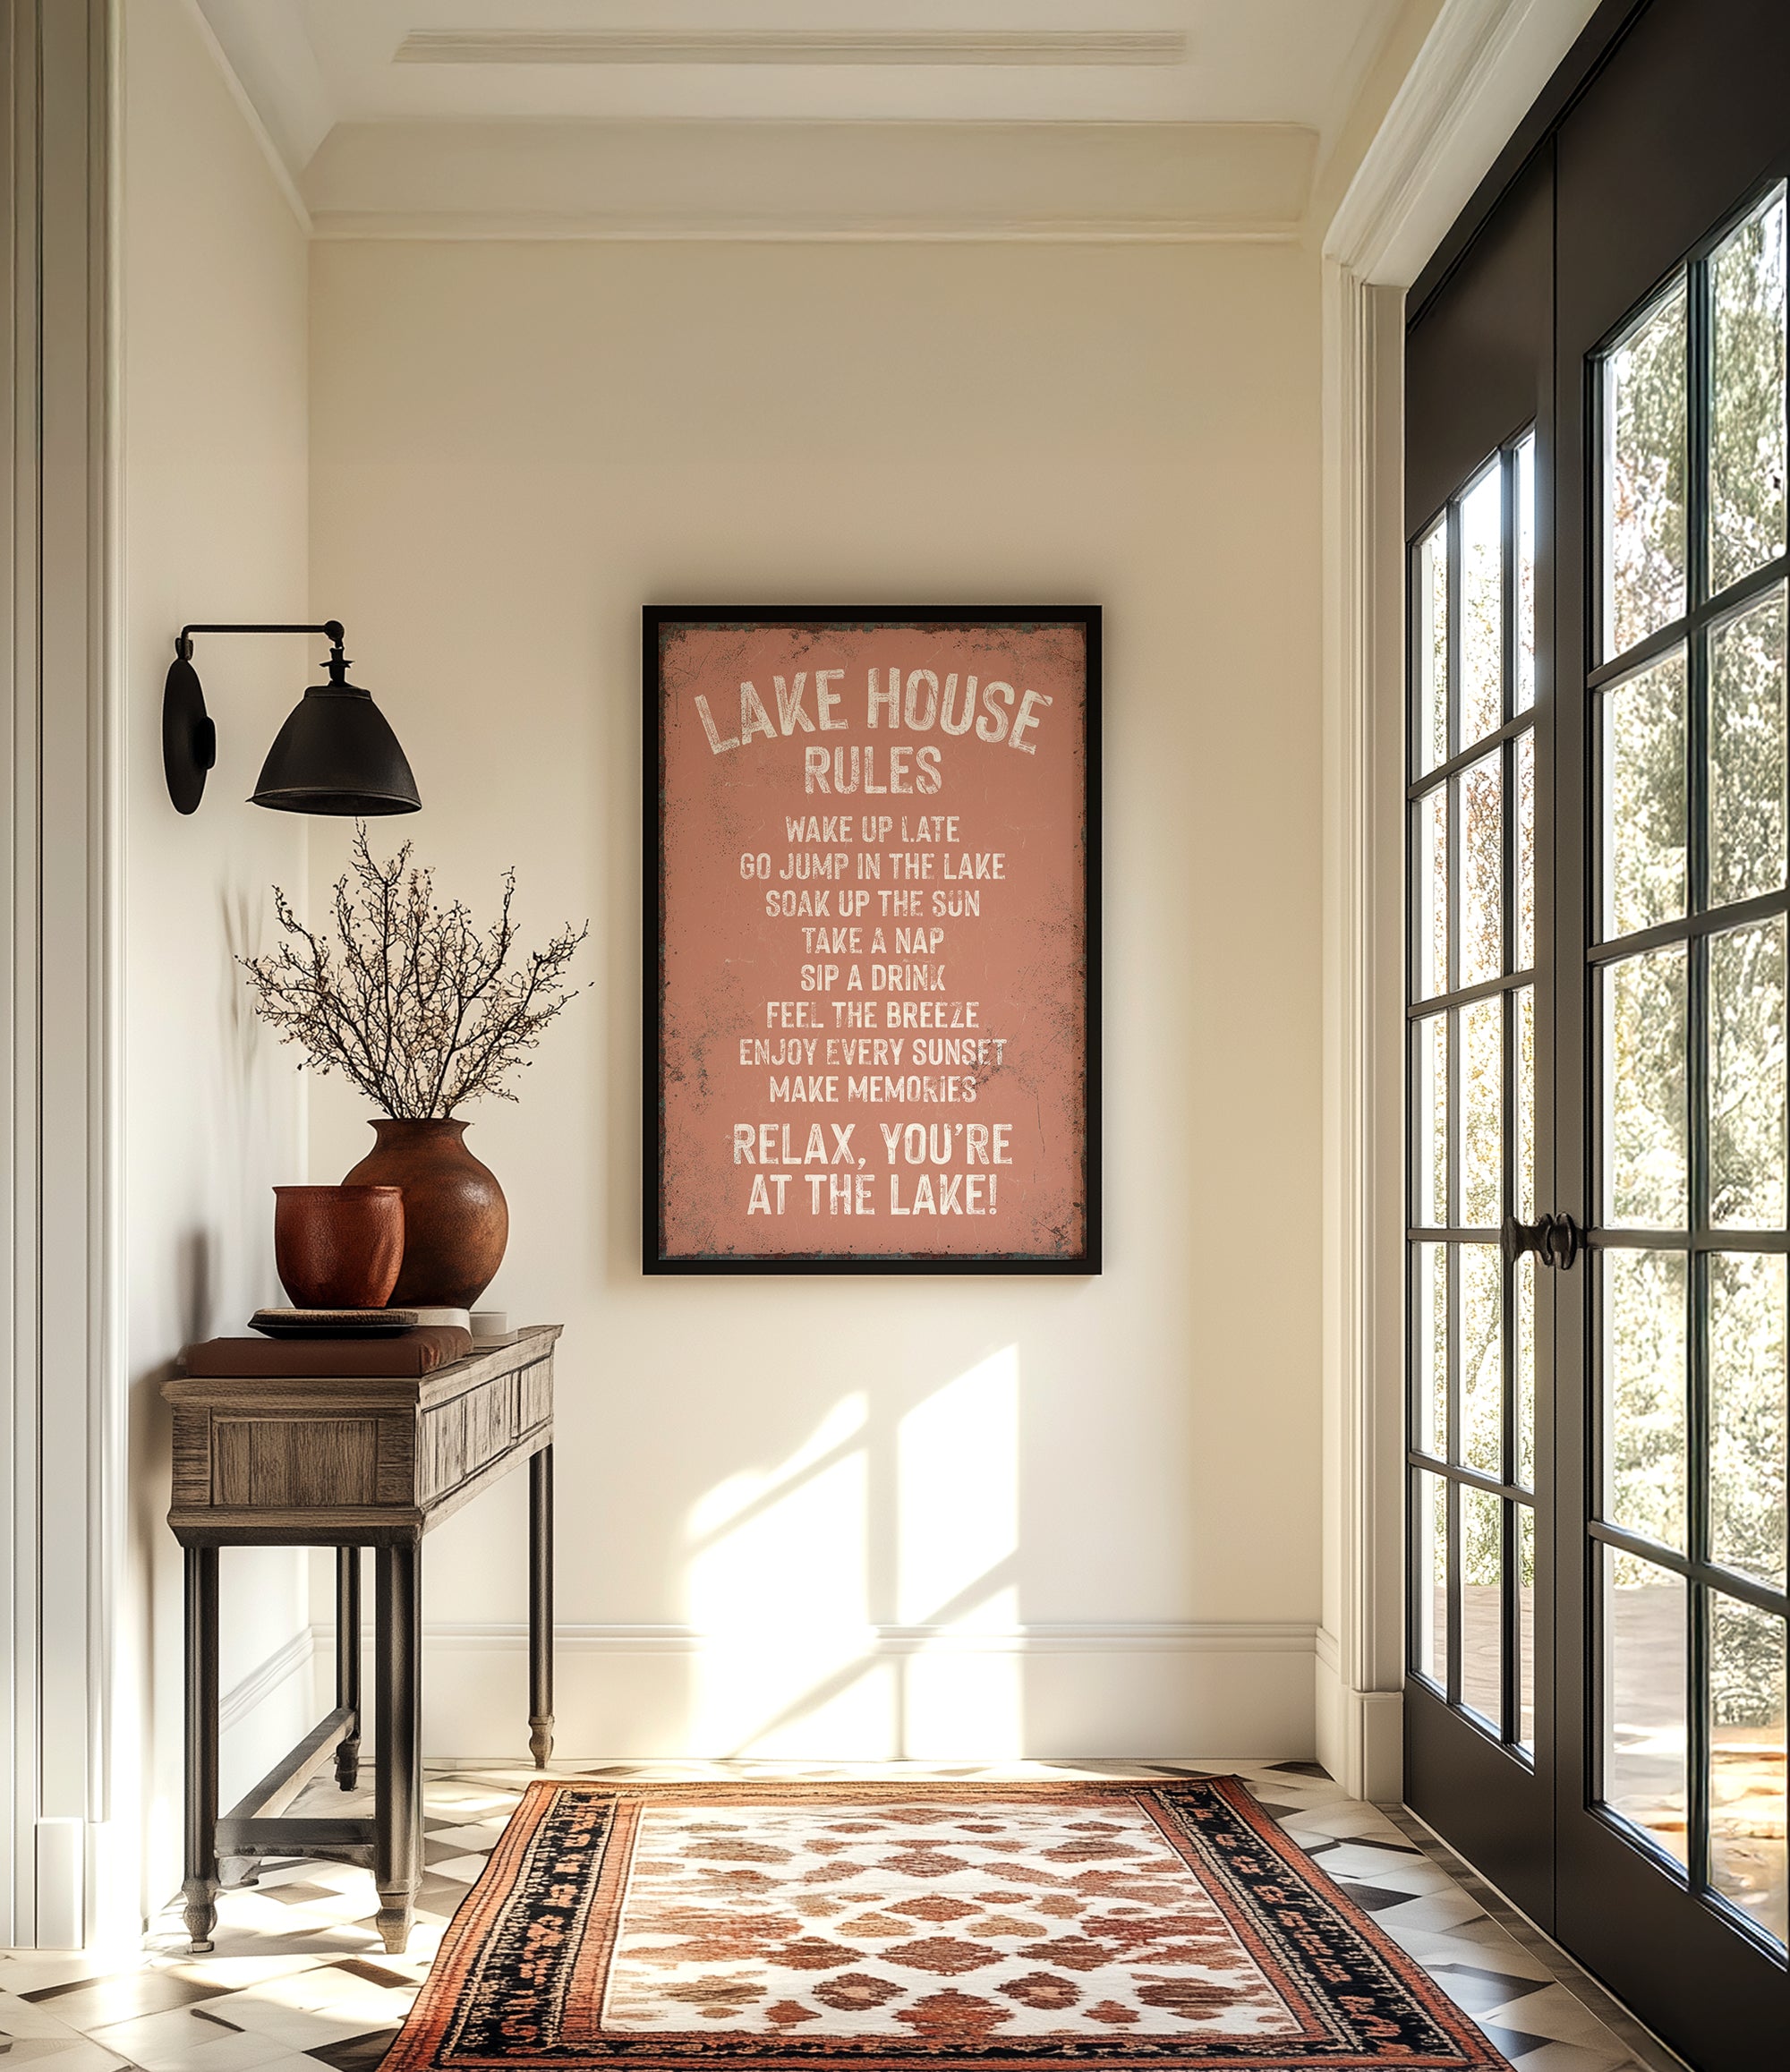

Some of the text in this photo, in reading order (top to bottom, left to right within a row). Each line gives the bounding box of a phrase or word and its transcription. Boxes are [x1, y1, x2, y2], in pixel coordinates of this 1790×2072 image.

[695, 667, 1053, 755] LAKE HOUSE
[805, 746, 942, 795] RULES
[785, 815, 960, 843] WAKE UP LATE
[740, 852, 1006, 881] GO JUMP IN THE LAKE
[765, 889, 980, 917] SOAK UP THE SUN
[801, 926, 944, 955] TAKE A NAP
[800, 964, 946, 992] SIP A DRINK
[766, 1001, 980, 1029] FEEL THE BREEZE
[739, 1037, 1008, 1066] ENJOY EVERY SUNSET
[769, 1075, 977, 1104] MAKE MEMORIES
[733, 1122, 1013, 1171] RELAX, YOU'RE
[746, 1172, 998, 1216] AT THE LAKE!
